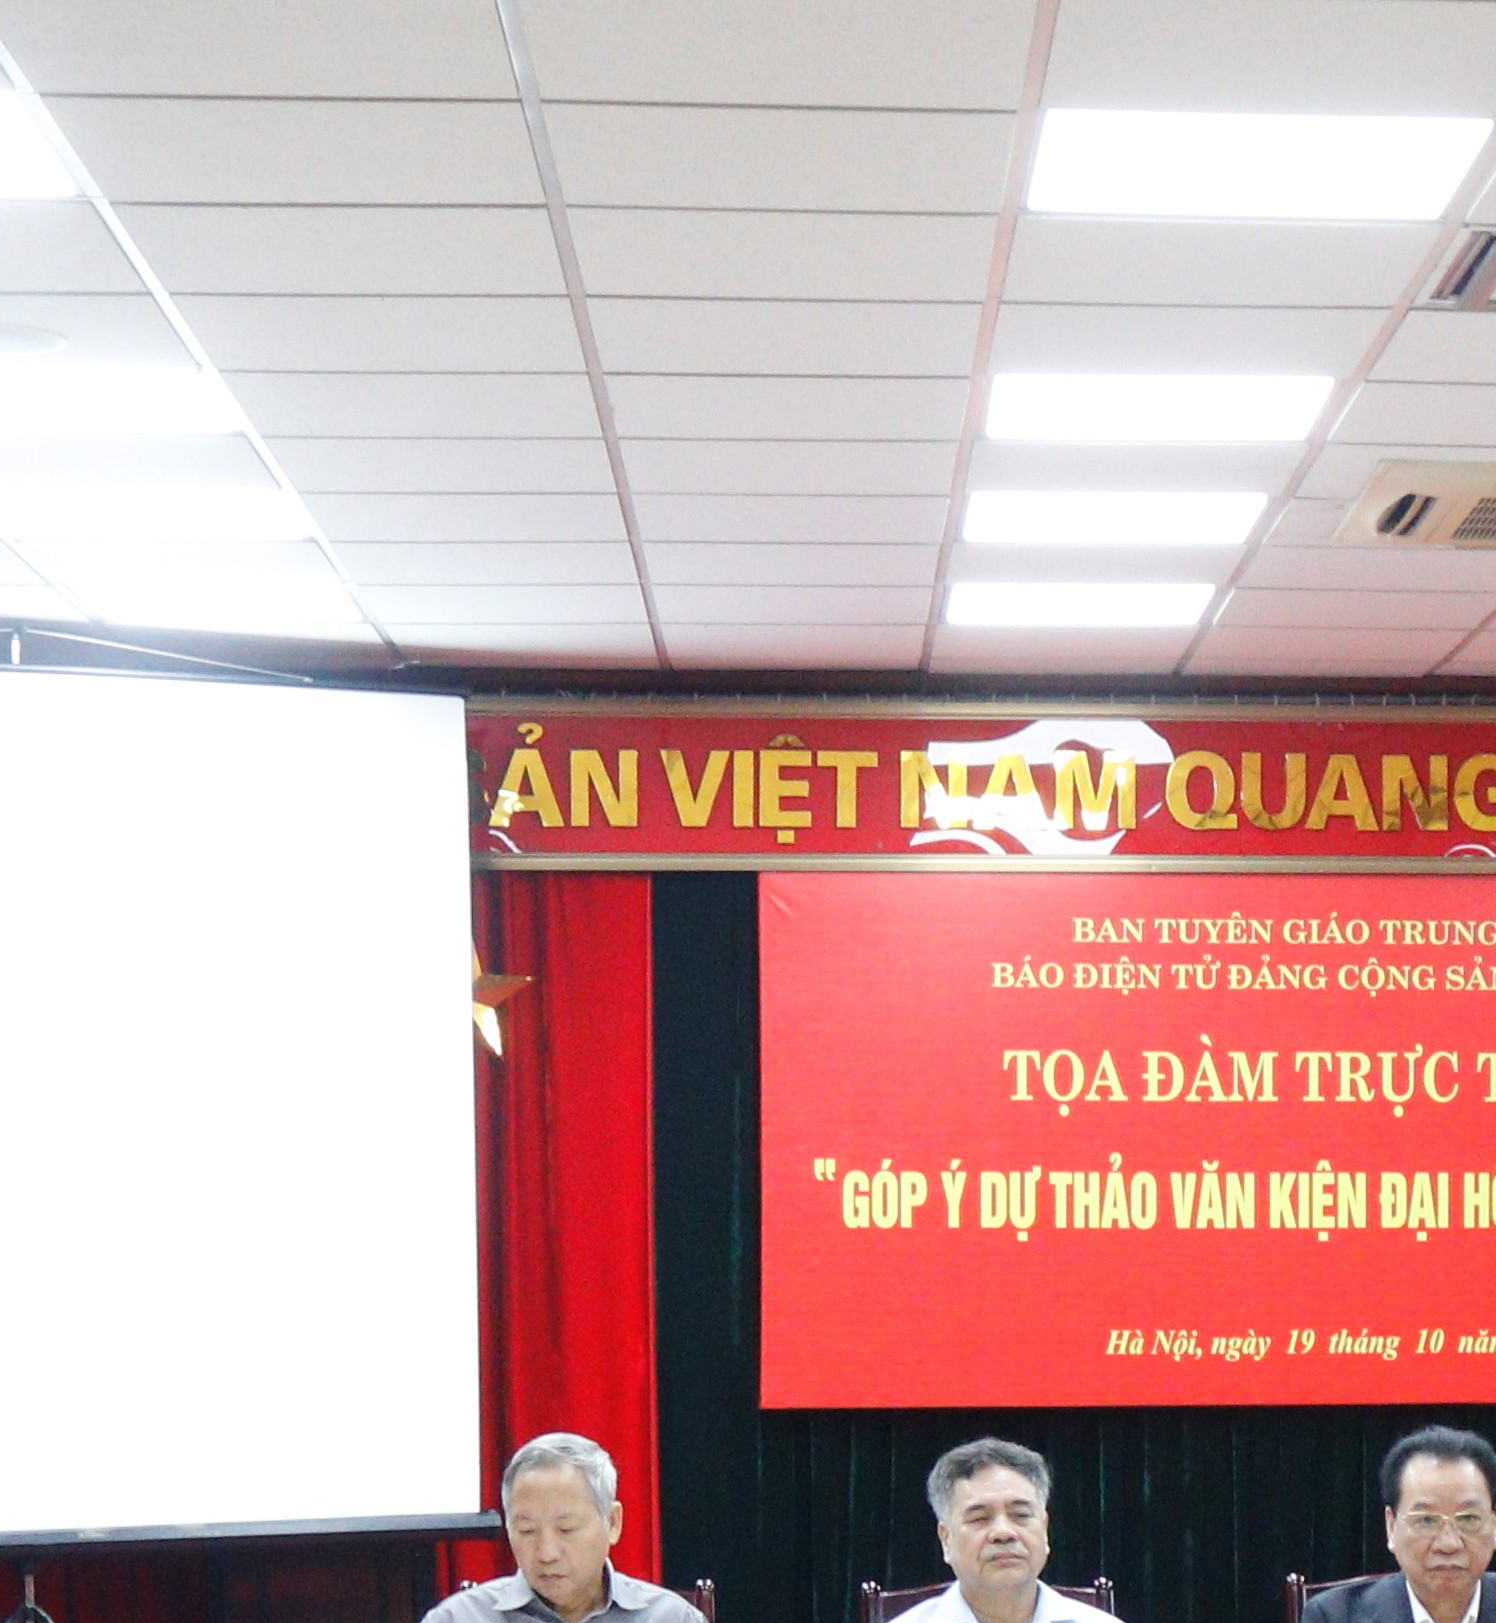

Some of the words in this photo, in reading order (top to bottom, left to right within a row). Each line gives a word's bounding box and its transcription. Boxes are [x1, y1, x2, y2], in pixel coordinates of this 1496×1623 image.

[467, 722, 638, 828] ẢN
[660, 734, 878, 843] VIỆT
[900, 749, 1136, 831] NAM
[1072, 917, 1145, 943] BAN
[1154, 911, 1273, 944] TUYÊN
[1283, 912, 1369, 944] GIÁO
[991, 955, 1064, 988] BÁO
[1073, 956, 1162, 995] ĐIỆN
[1171, 954, 1221, 989] TỬ
[1228, 955, 1327, 989] ĐẢNG
[1338, 958, 1436, 997] CỘNG
[1003, 1049, 1128, 1116] TỌA
[1142, 1034, 1278, 1101] ĐÀM
[1295, 1044, 1458, 1117] TRỰC
[941, 1159, 967, 1228] Ý
[980, 1166, 1042, 1241] DỰ
[1049, 1152, 1157, 1229] THẢO
[1171, 1160, 1255, 1229] VĂN
[1270, 1160, 1366, 1241] KIỆN
[1379, 1172, 1449, 1241] ĐẠI
[1107, 1330, 1144, 1354] Hà
[1152, 1330, 1202, 1361] Nội,
[1211, 1330, 1271, 1361] ngày
[1288, 1330, 1315, 1354] 19
[1329, 1329, 1400, 1360] tháng
[1417, 1329, 1444, 1353] 10
